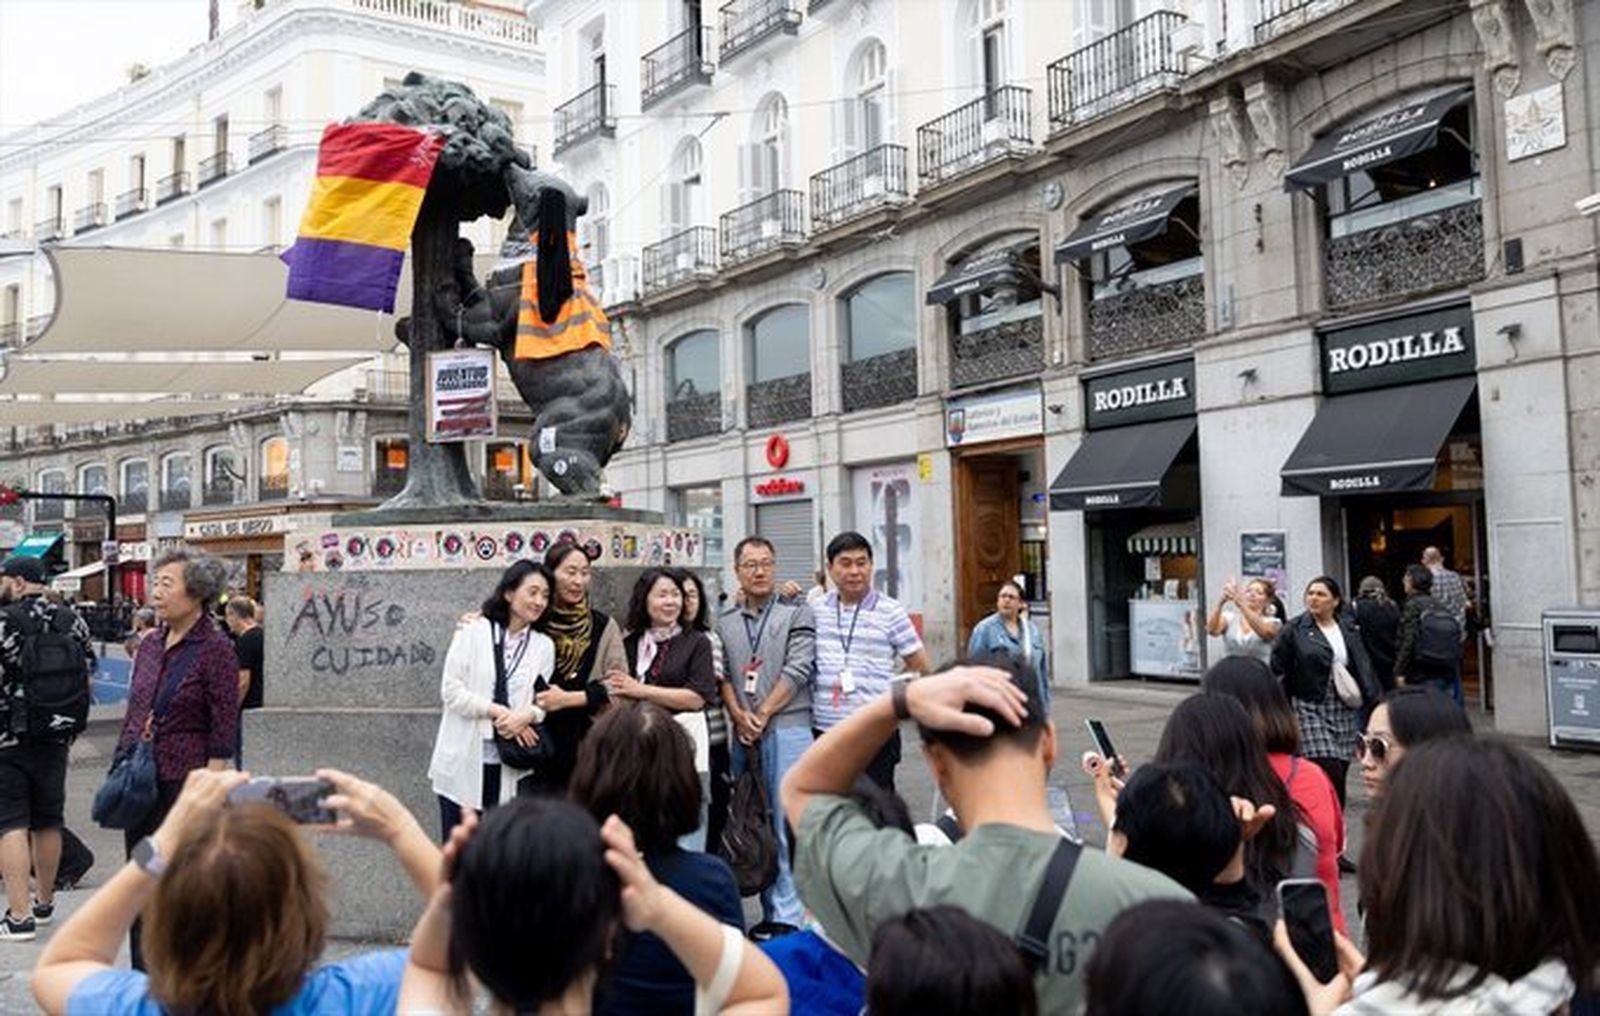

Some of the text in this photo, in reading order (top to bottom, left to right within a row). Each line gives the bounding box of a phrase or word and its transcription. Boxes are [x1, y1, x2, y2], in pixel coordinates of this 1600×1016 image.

[1329, 327, 1465, 373] RODILLA
[1094, 377, 1187, 411] RODILLA
[1330, 476, 1380, 490] RODILLA
[311, 641, 436, 676] CUIDADO
